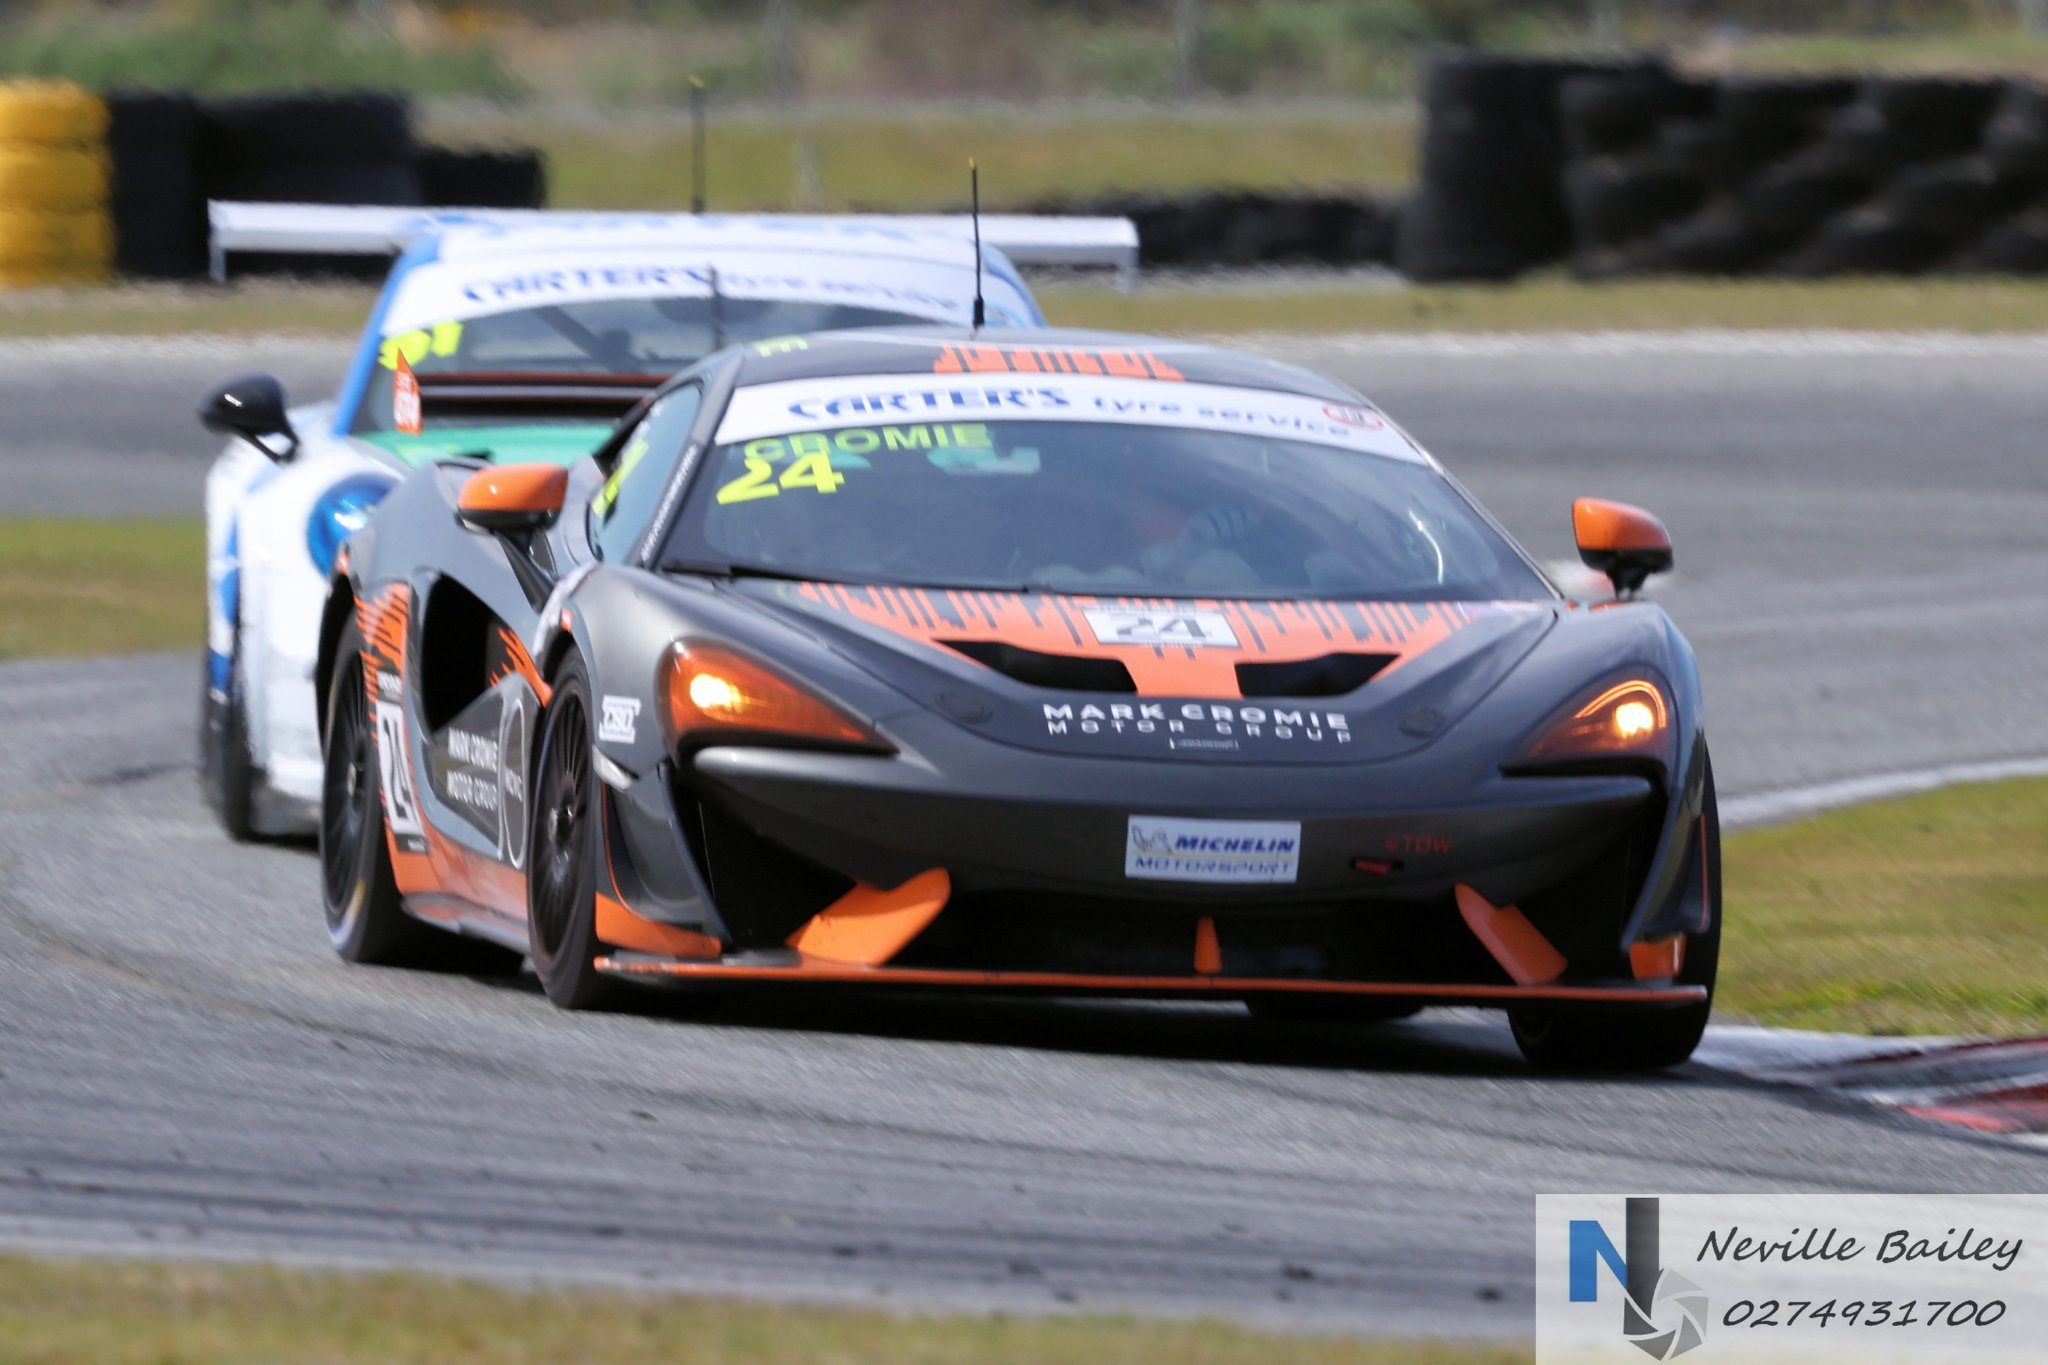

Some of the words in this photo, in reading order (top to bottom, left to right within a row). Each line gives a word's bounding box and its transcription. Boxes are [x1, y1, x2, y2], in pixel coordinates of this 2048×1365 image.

[788, 386, 1071, 418] CARTER'S
[1092, 395, 1183, 415] tyre
[1197, 406, 1352, 437] service
[744, 423, 994, 463] CROMIE
[715, 451, 846, 505] 24
[1042, 703, 1166, 721] MARK
[1180, 703, 1350, 731] CROMIE
[1047, 719, 1185, 735] MOTOR
[1215, 720, 1351, 744] GROUP
[1174, 834, 1295, 854] MICHELIN
[1134, 855, 1292, 875] MOTORSPORT
